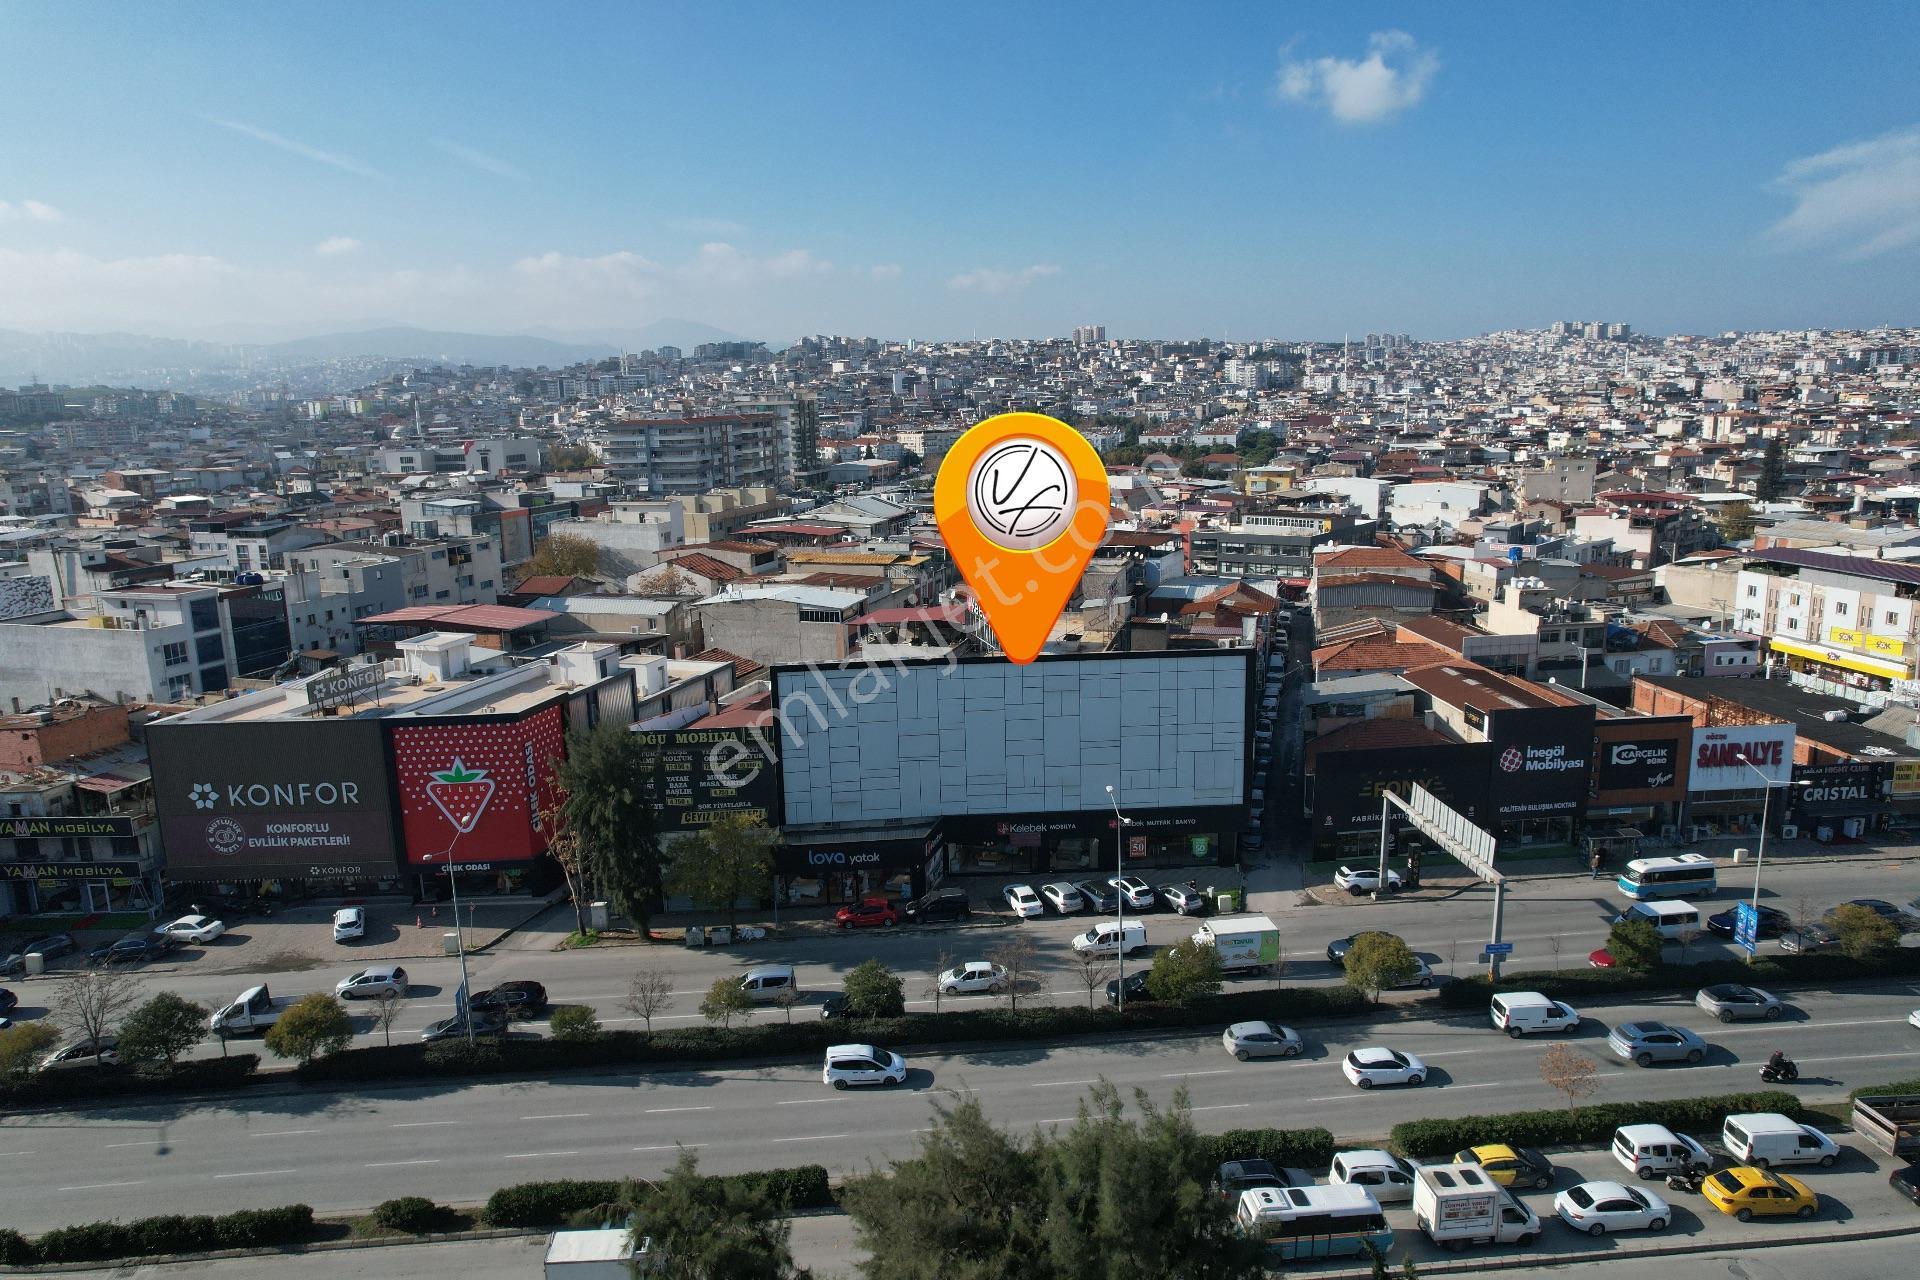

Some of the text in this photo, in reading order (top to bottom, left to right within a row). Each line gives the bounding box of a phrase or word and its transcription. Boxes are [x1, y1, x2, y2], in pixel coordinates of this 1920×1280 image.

[329, 668, 385, 694] KONFOR
[676, 730, 738, 744] MOBİLYA
[663, 755, 693, 763] KOLTUK
[1526, 746, 1565, 759] İnegöl
[1698, 741, 1784, 767] SANDALYE
[1526, 759, 1584, 772] Mobilyası
[228, 782, 359, 807] KONFOR
[436, 784, 487, 796] ÇİLEK
[666, 788, 693, 797] BAŞLIK
[1803, 785, 1868, 802] CRISTAL
[54, 821, 116, 833] MOBİLYA
[207, 819, 242, 835] MUTLULUK
[266, 823, 330, 834] KONFOR'LU
[1010, 822, 1047, 834] Kelebek
[248, 835, 351, 848] EVLİLİK PAKETLERİ!
[808, 850, 880, 865] lova yatak
[3, 864, 123, 878] YAMAN MOBİLYA
[321, 866, 361, 875] KONFOR
[465, 863, 490, 873] ODASI
